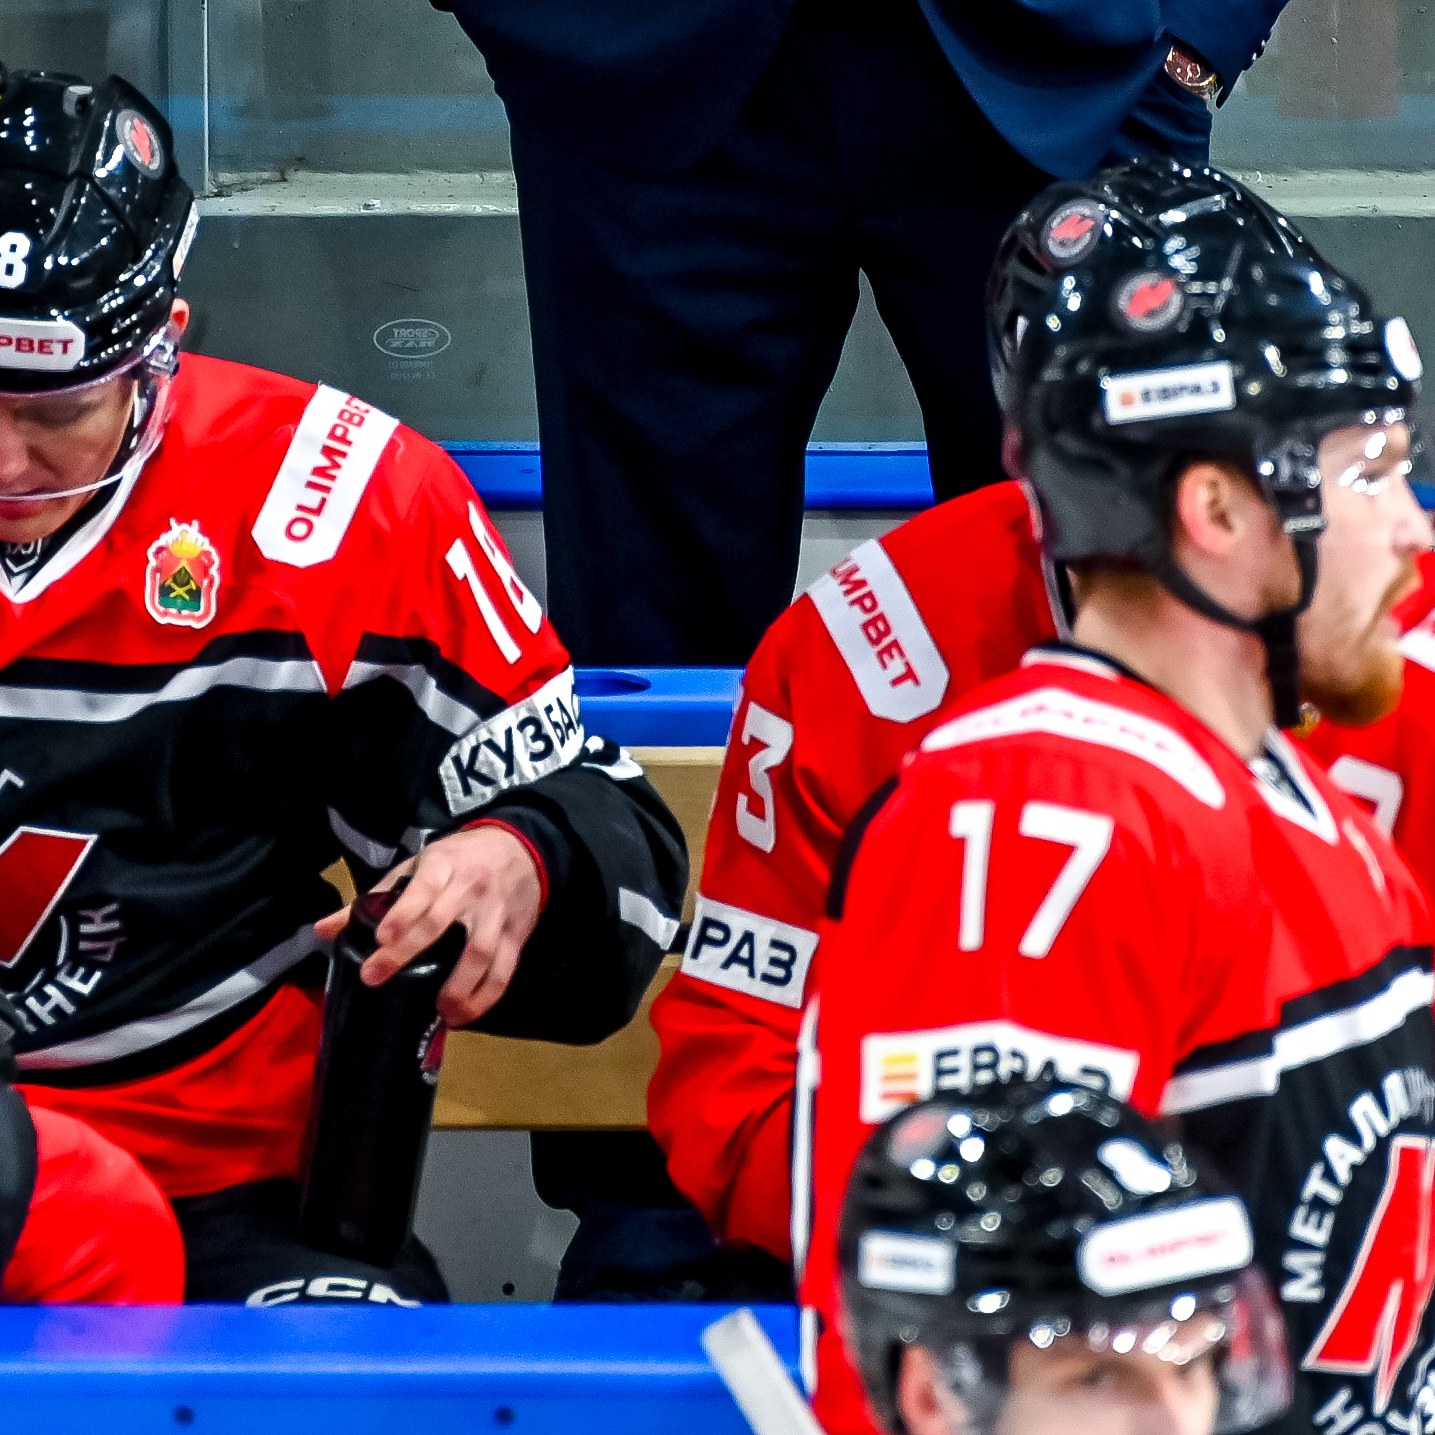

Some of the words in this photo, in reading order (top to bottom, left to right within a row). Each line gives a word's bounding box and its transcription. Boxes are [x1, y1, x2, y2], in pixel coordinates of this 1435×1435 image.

[445, 500, 543, 664] 18
[689, 916, 799, 986] РАЗ
[949, 799, 1115, 959] 17
